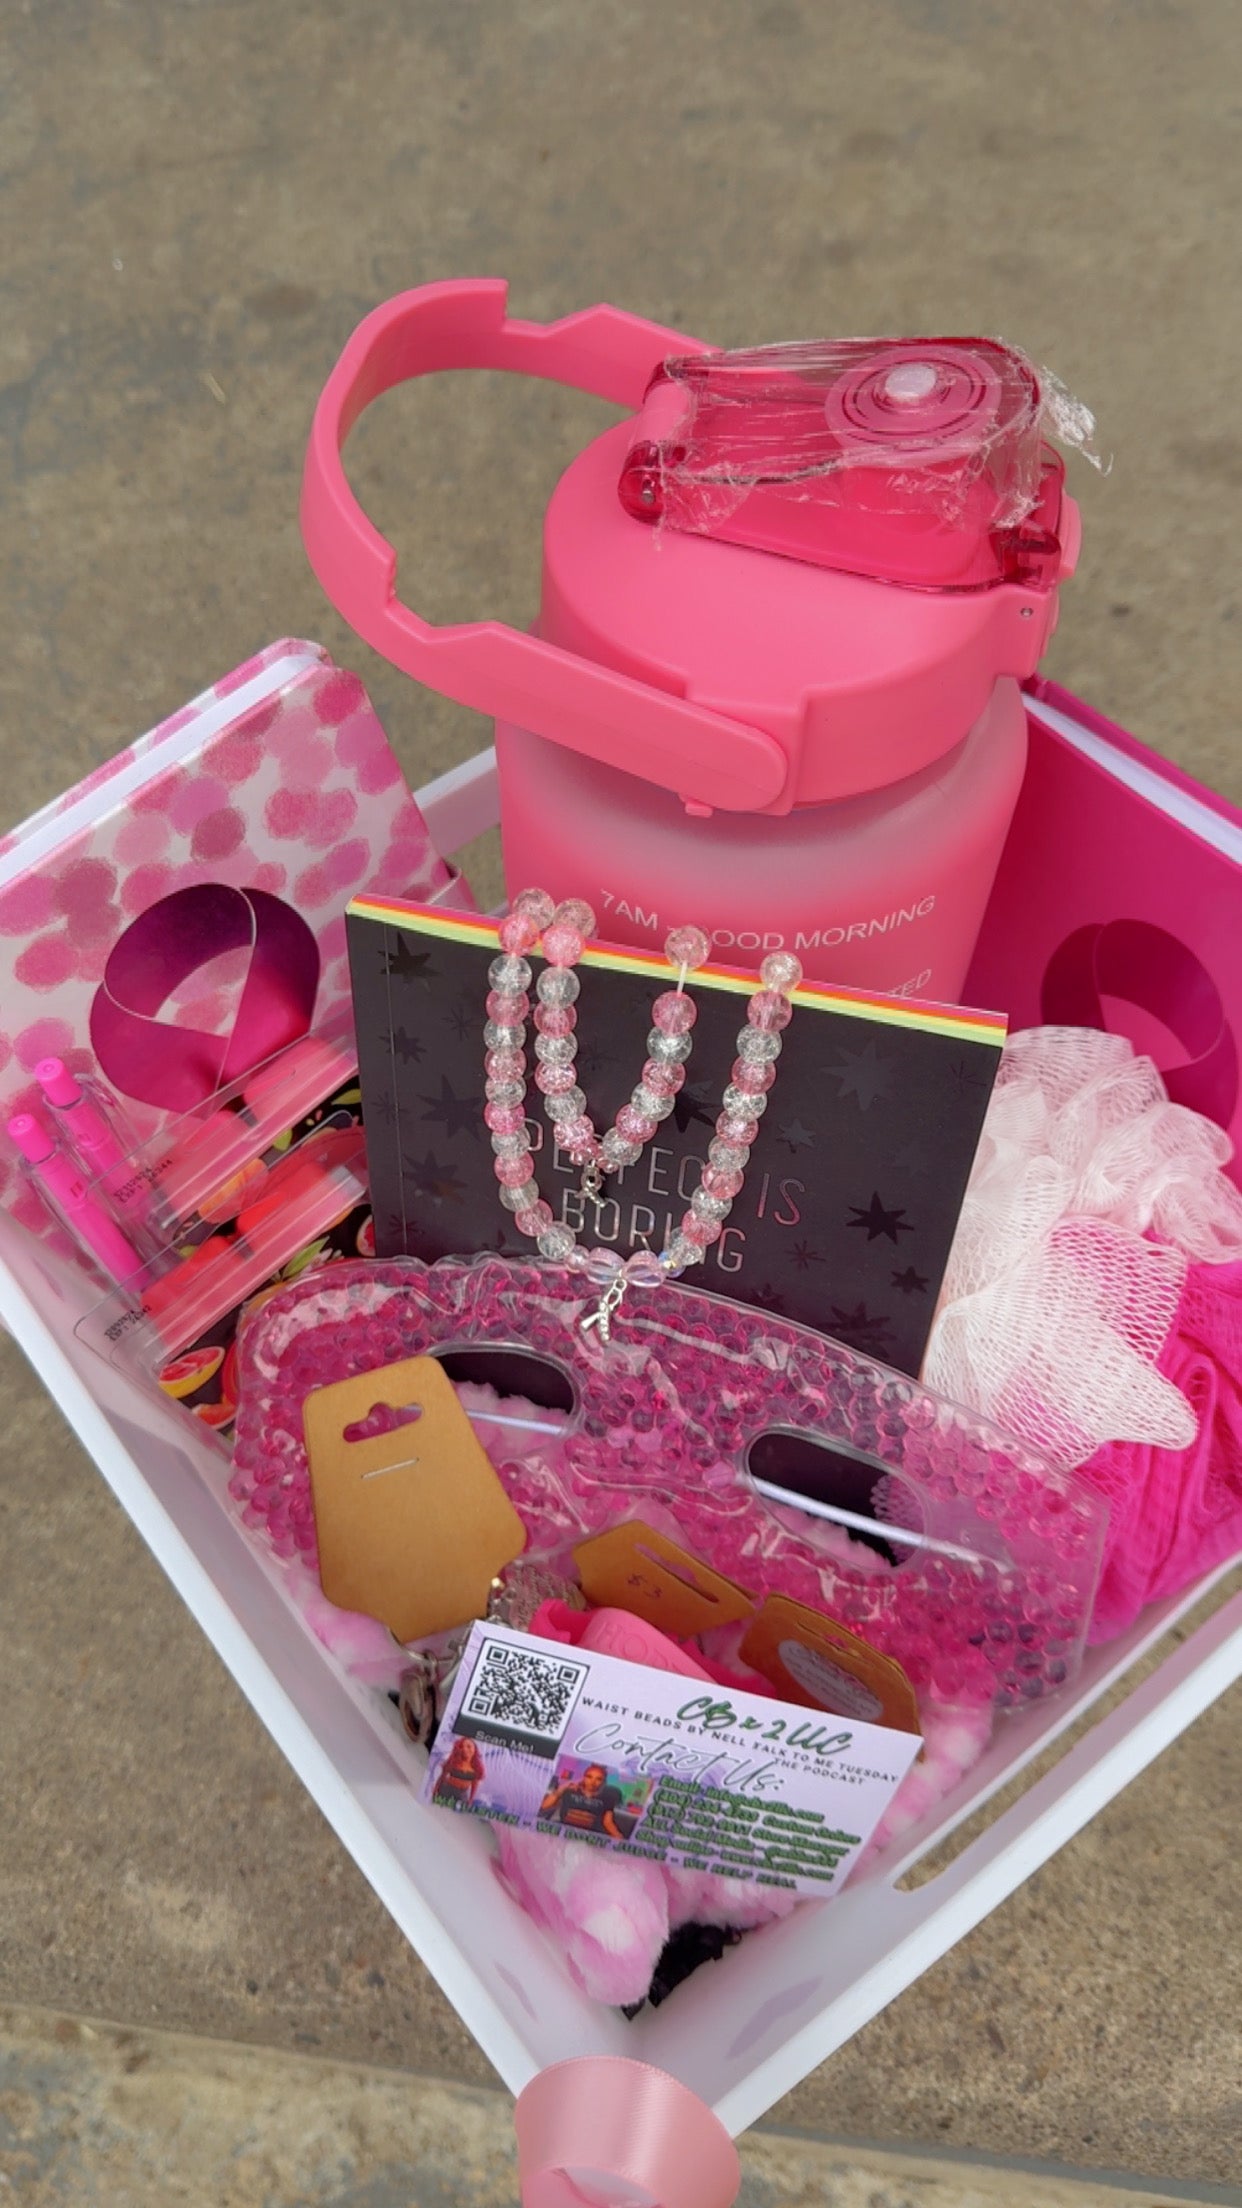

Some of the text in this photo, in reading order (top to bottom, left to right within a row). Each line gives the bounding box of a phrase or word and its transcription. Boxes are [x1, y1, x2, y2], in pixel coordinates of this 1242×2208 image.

[600, 889, 936, 951] 7AM OOD MORNING
[756, 1172, 806, 1226] IS
[560, 1187, 747, 1273] BORIG
[474, 1729, 508, 1748] Scan
[575, 1722, 740, 1782] Contact
[582, 1696, 899, 1784] WAIST BEADS BY NELL TALK TO ME TUESDAY
[774, 1757, 866, 1786] THE PODCAST
